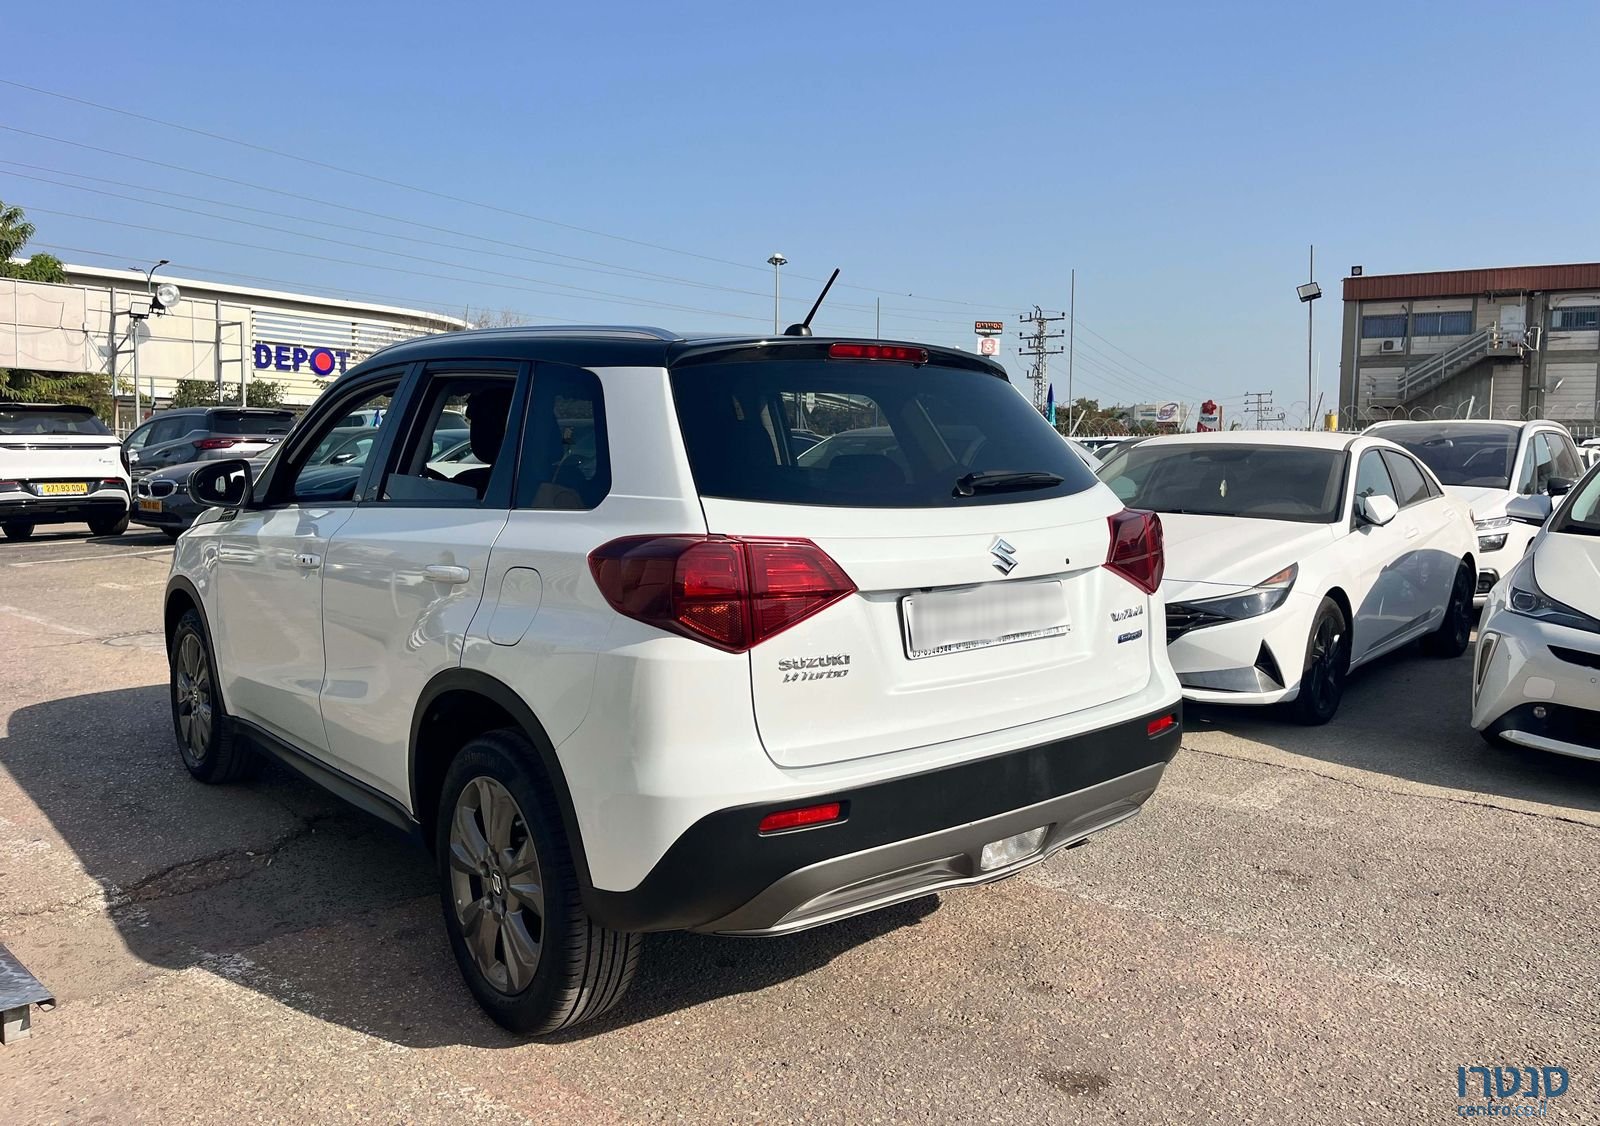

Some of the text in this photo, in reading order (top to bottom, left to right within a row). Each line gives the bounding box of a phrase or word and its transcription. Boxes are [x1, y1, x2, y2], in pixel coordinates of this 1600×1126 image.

[255, 344, 351, 376] DEPOT
[778, 654, 850, 671] SUZUKI
[801, 668, 849, 681] Turbo
